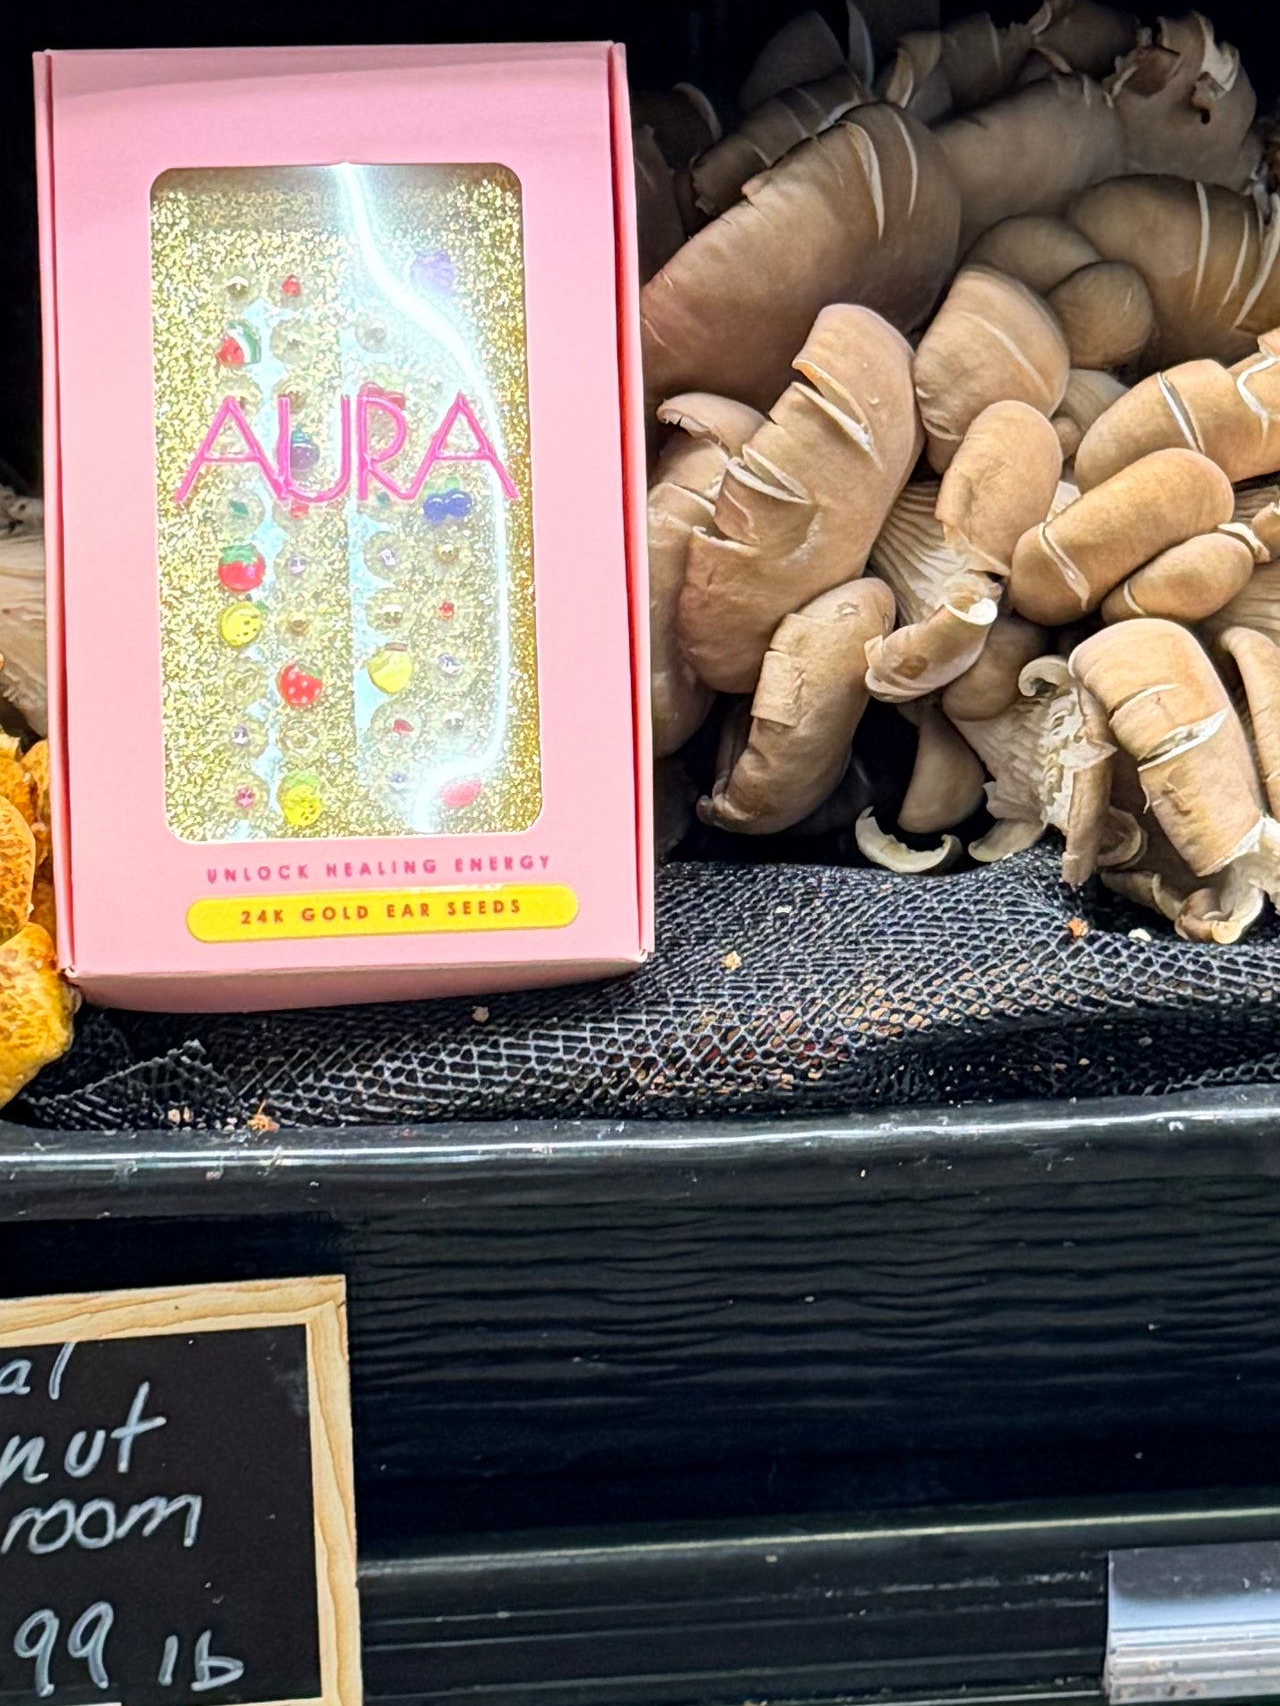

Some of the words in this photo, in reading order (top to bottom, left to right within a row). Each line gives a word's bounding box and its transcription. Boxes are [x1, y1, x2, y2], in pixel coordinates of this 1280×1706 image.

[174, 390, 519, 504] AURA
[206, 863, 310, 885] UNLOCK
[325, 858, 438, 879] HEALING
[454, 854, 552, 873] ENERGY
[240, 908, 285, 926] 24K
[301, 904, 370, 923] GOLD
[386, 901, 431, 919] EAR
[446, 898, 522, 916] SEEDS
[157, 1630, 246, 1691] lb
